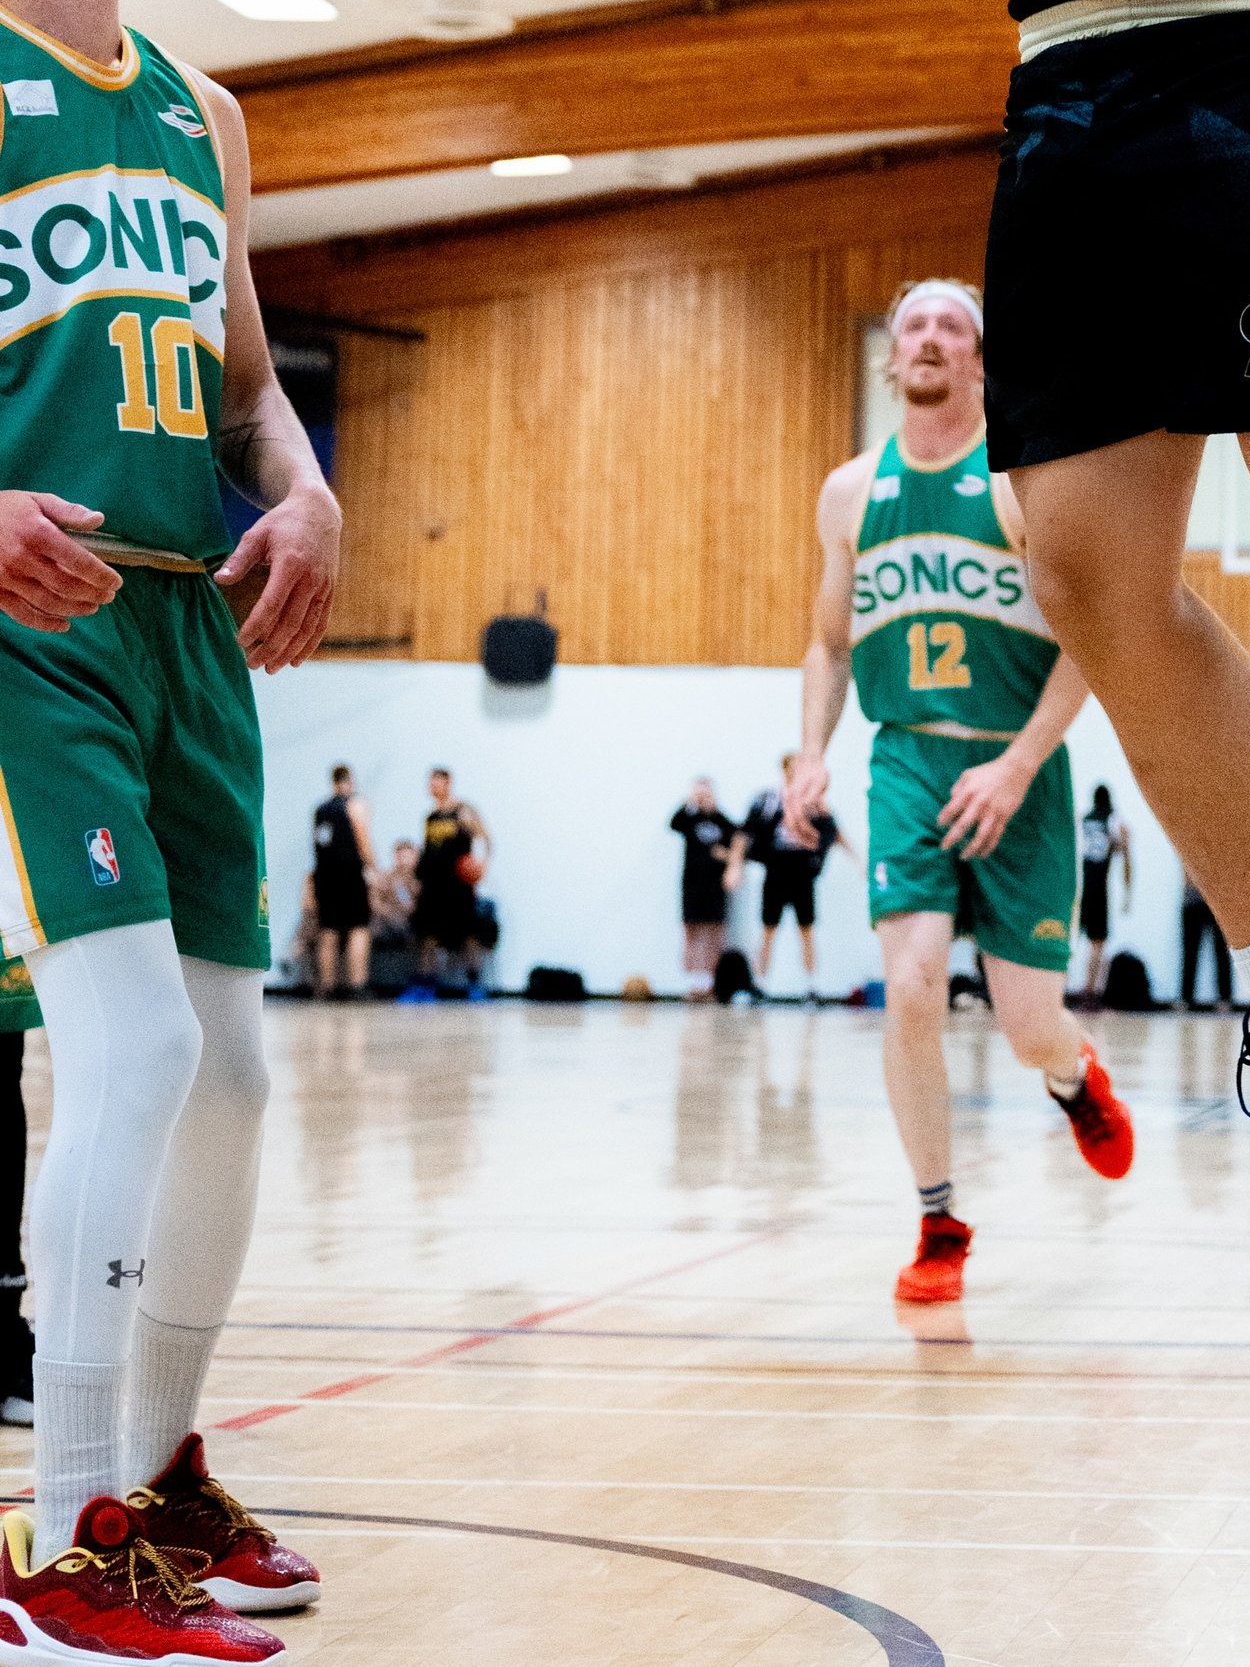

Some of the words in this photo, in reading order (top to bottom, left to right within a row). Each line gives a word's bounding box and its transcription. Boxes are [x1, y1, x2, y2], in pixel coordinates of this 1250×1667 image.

[0, 191, 226, 326] SONIC
[107, 311, 209, 440] 10
[907, 622, 971, 690] 12
